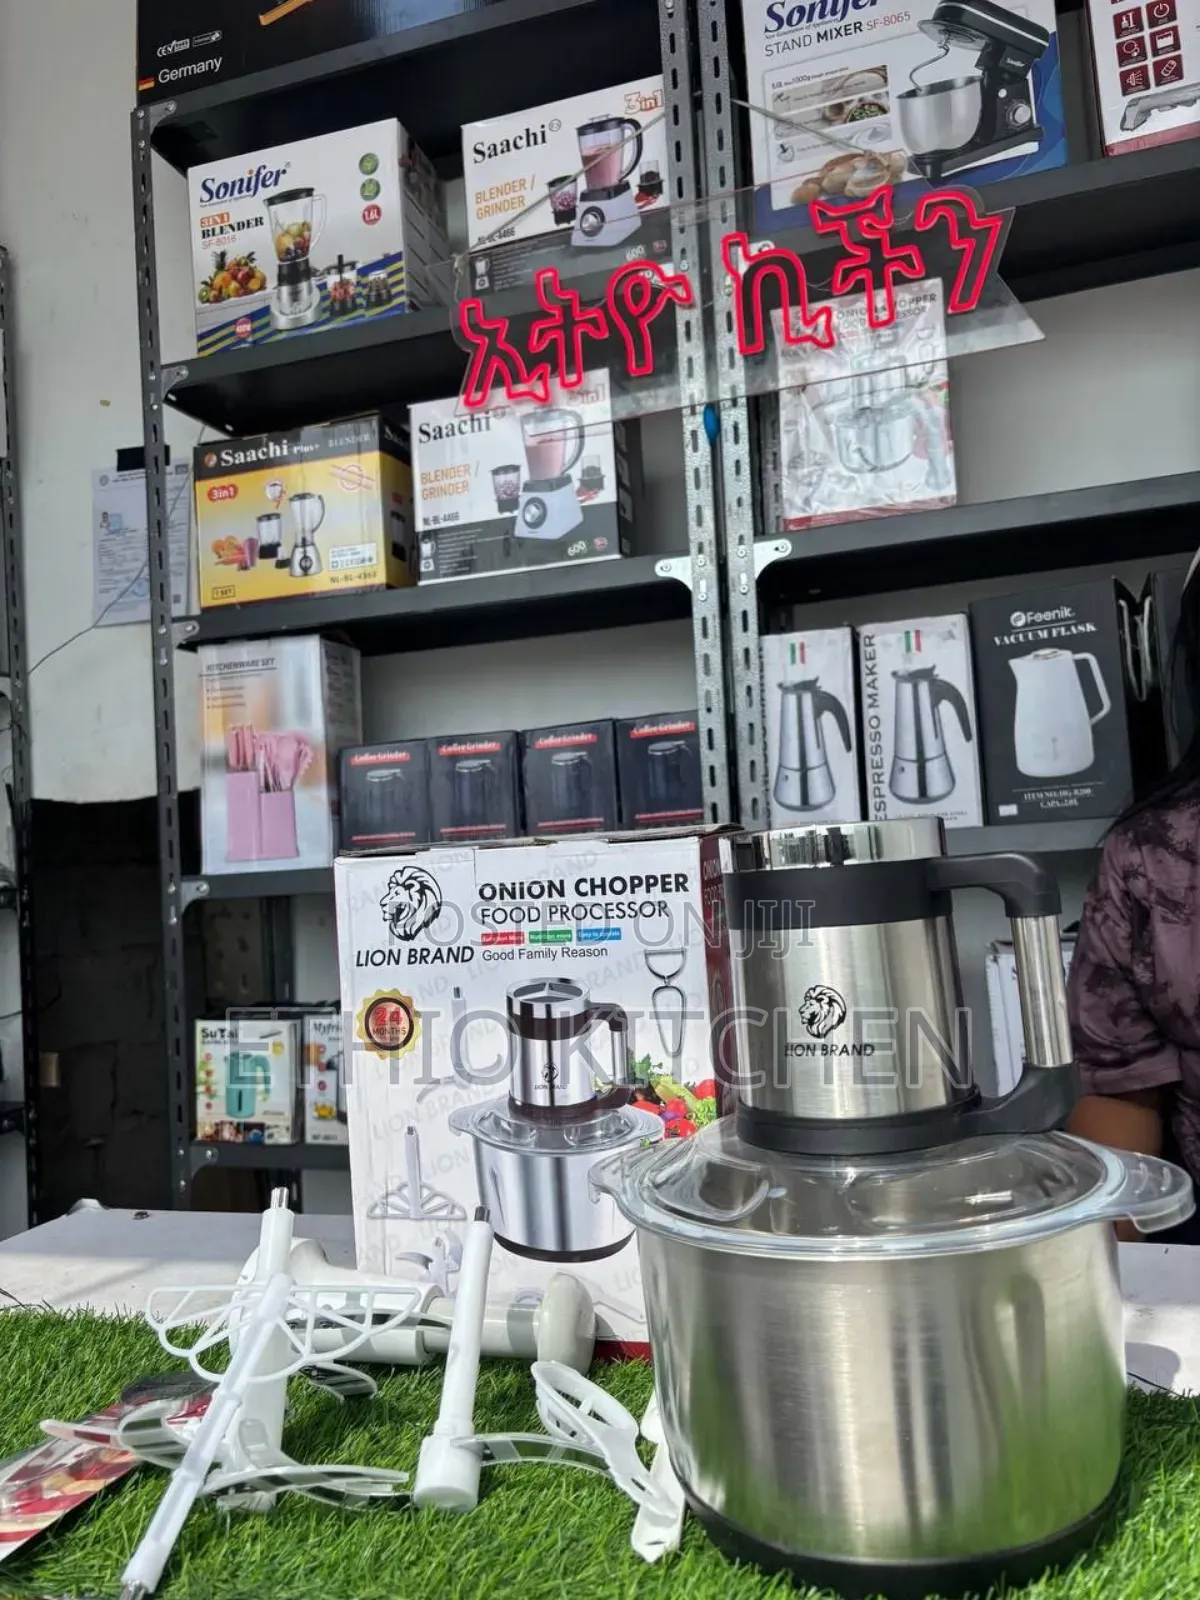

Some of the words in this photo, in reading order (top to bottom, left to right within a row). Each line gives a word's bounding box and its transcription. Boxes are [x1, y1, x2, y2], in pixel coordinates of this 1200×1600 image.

[764, 35, 813, 58] STAND
[816, 21, 864, 44] MIXER
[866, 11, 911, 31] SF-8065
[158, 56, 223, 83] Germany
[625, 89, 664, 115] 3in1
[473, 124, 548, 165] Saachi
[200, 163, 288, 204] Sonifer
[475, 178, 527, 205] BLENDER
[476, 196, 526, 221] GRINDER
[201, 216, 264, 239] BLENDER
[418, 411, 491, 444] Saachi
[220, 438, 289, 467] Saachi
[420, 462, 471, 485] BLENDER
[211, 486, 235, 500] 3in1
[421, 479, 470, 501] GRINDER
[993, 628, 1049, 647] VACUUM
[1051, 622, 1097, 638] FLASK
[863, 634, 881, 709] MAKER
[478, 879, 566, 902] ONION
[574, 873, 690, 897] CHOPPER
[480, 905, 541, 926] FOOD
[548, 900, 670, 923] PROCESSOR
[355, 948, 401, 967] LION
[406, 945, 475, 966] BRAND
[482, 949, 515, 961] Good
[518, 947, 558, 963] Family
[561, 946, 609, 959] Reason
[374, 1006, 403, 1026] 24
[784, 1043, 816, 1057] LION
[820, 1043, 876, 1057] BRAND
